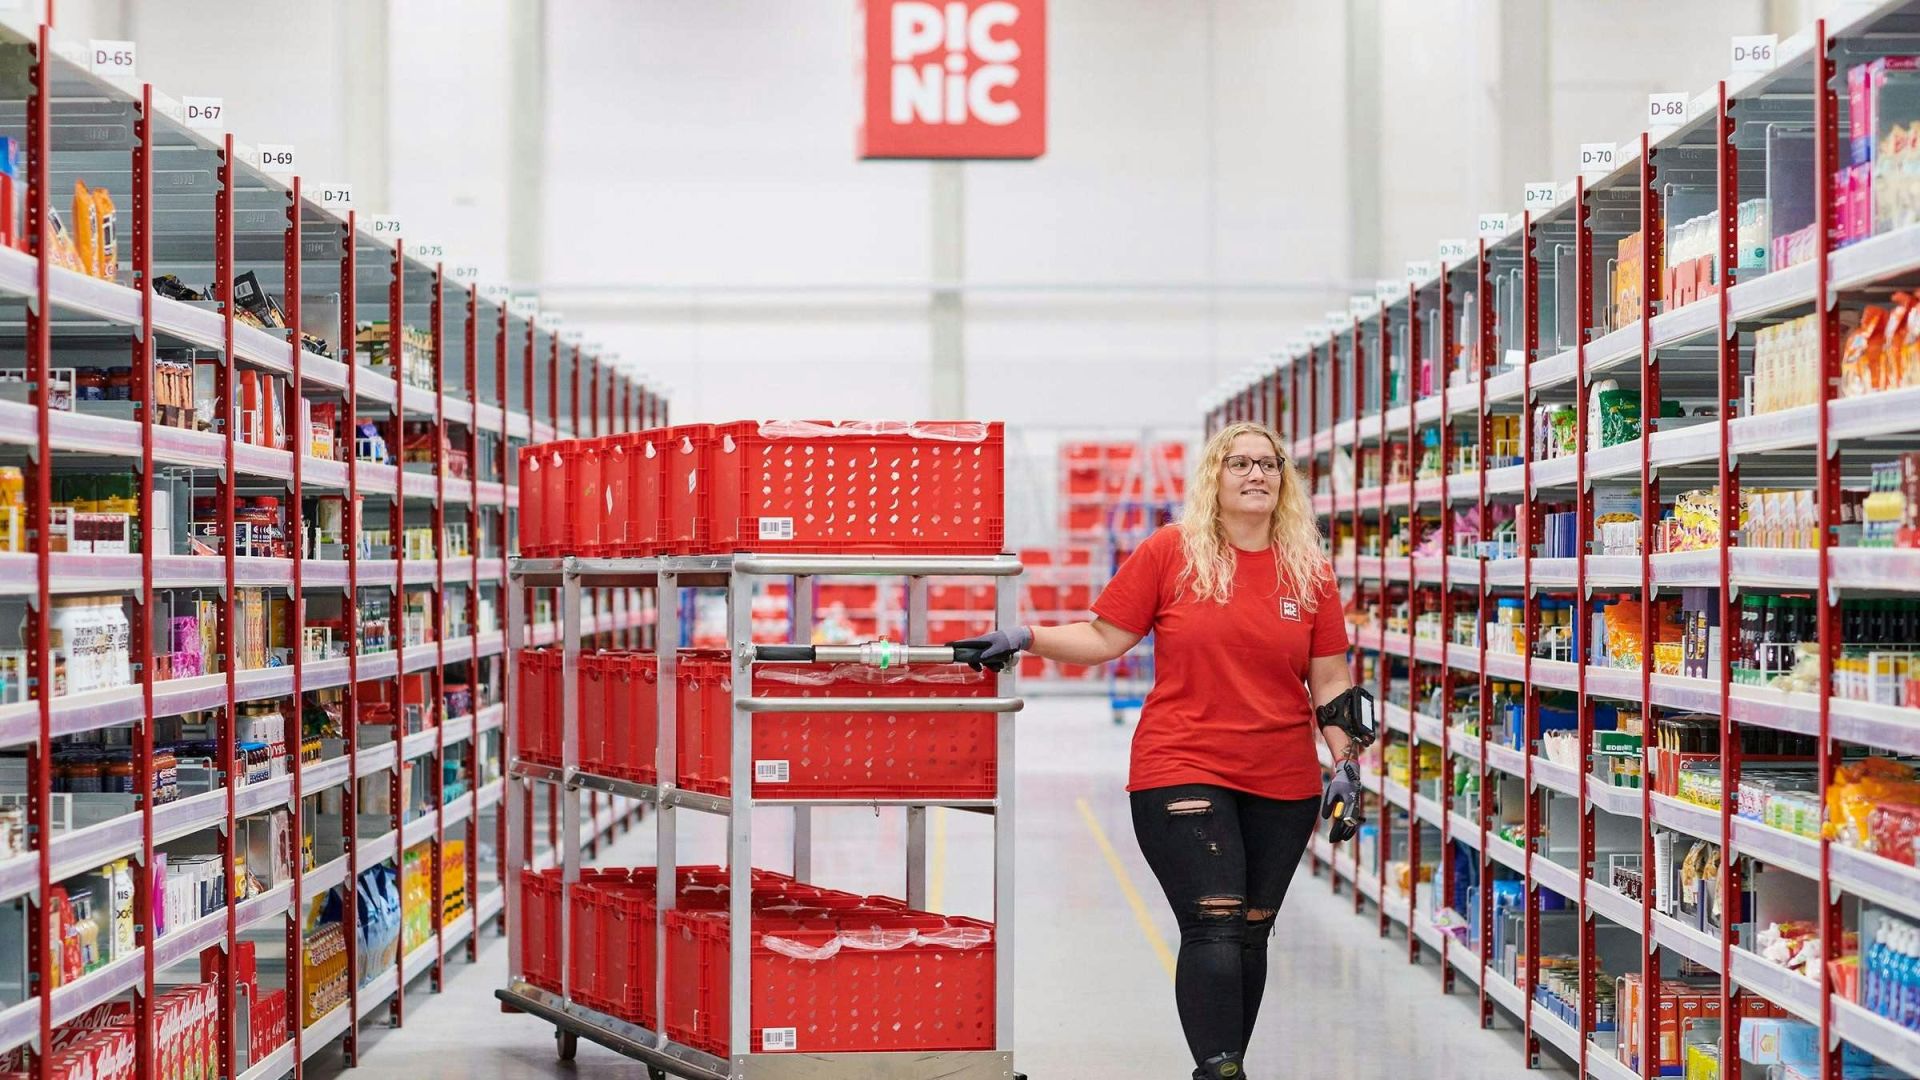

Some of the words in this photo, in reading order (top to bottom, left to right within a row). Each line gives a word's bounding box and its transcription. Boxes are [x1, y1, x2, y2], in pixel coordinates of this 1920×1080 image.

[890, 2, 1021, 62] PIC
[95, 49, 133, 66] D-65
[1734, 44, 1771, 62] D-66
[188, 105, 221, 120] D-67
[1651, 101, 1683, 116] D-68
[263, 152, 293, 165] D-69
[1582, 150, 1612, 164] D-70
[324, 190, 351, 202] D-71
[1526, 189, 1553, 202] D-72
[375, 220, 401, 232] D-73
[1480, 219, 1504, 231] D-74
[419, 246, 443, 256] D-75
[1440, 244, 1464, 256] D-76
[456, 267, 478, 277] D-77
[1283, 602, 1297, 610] PIC
